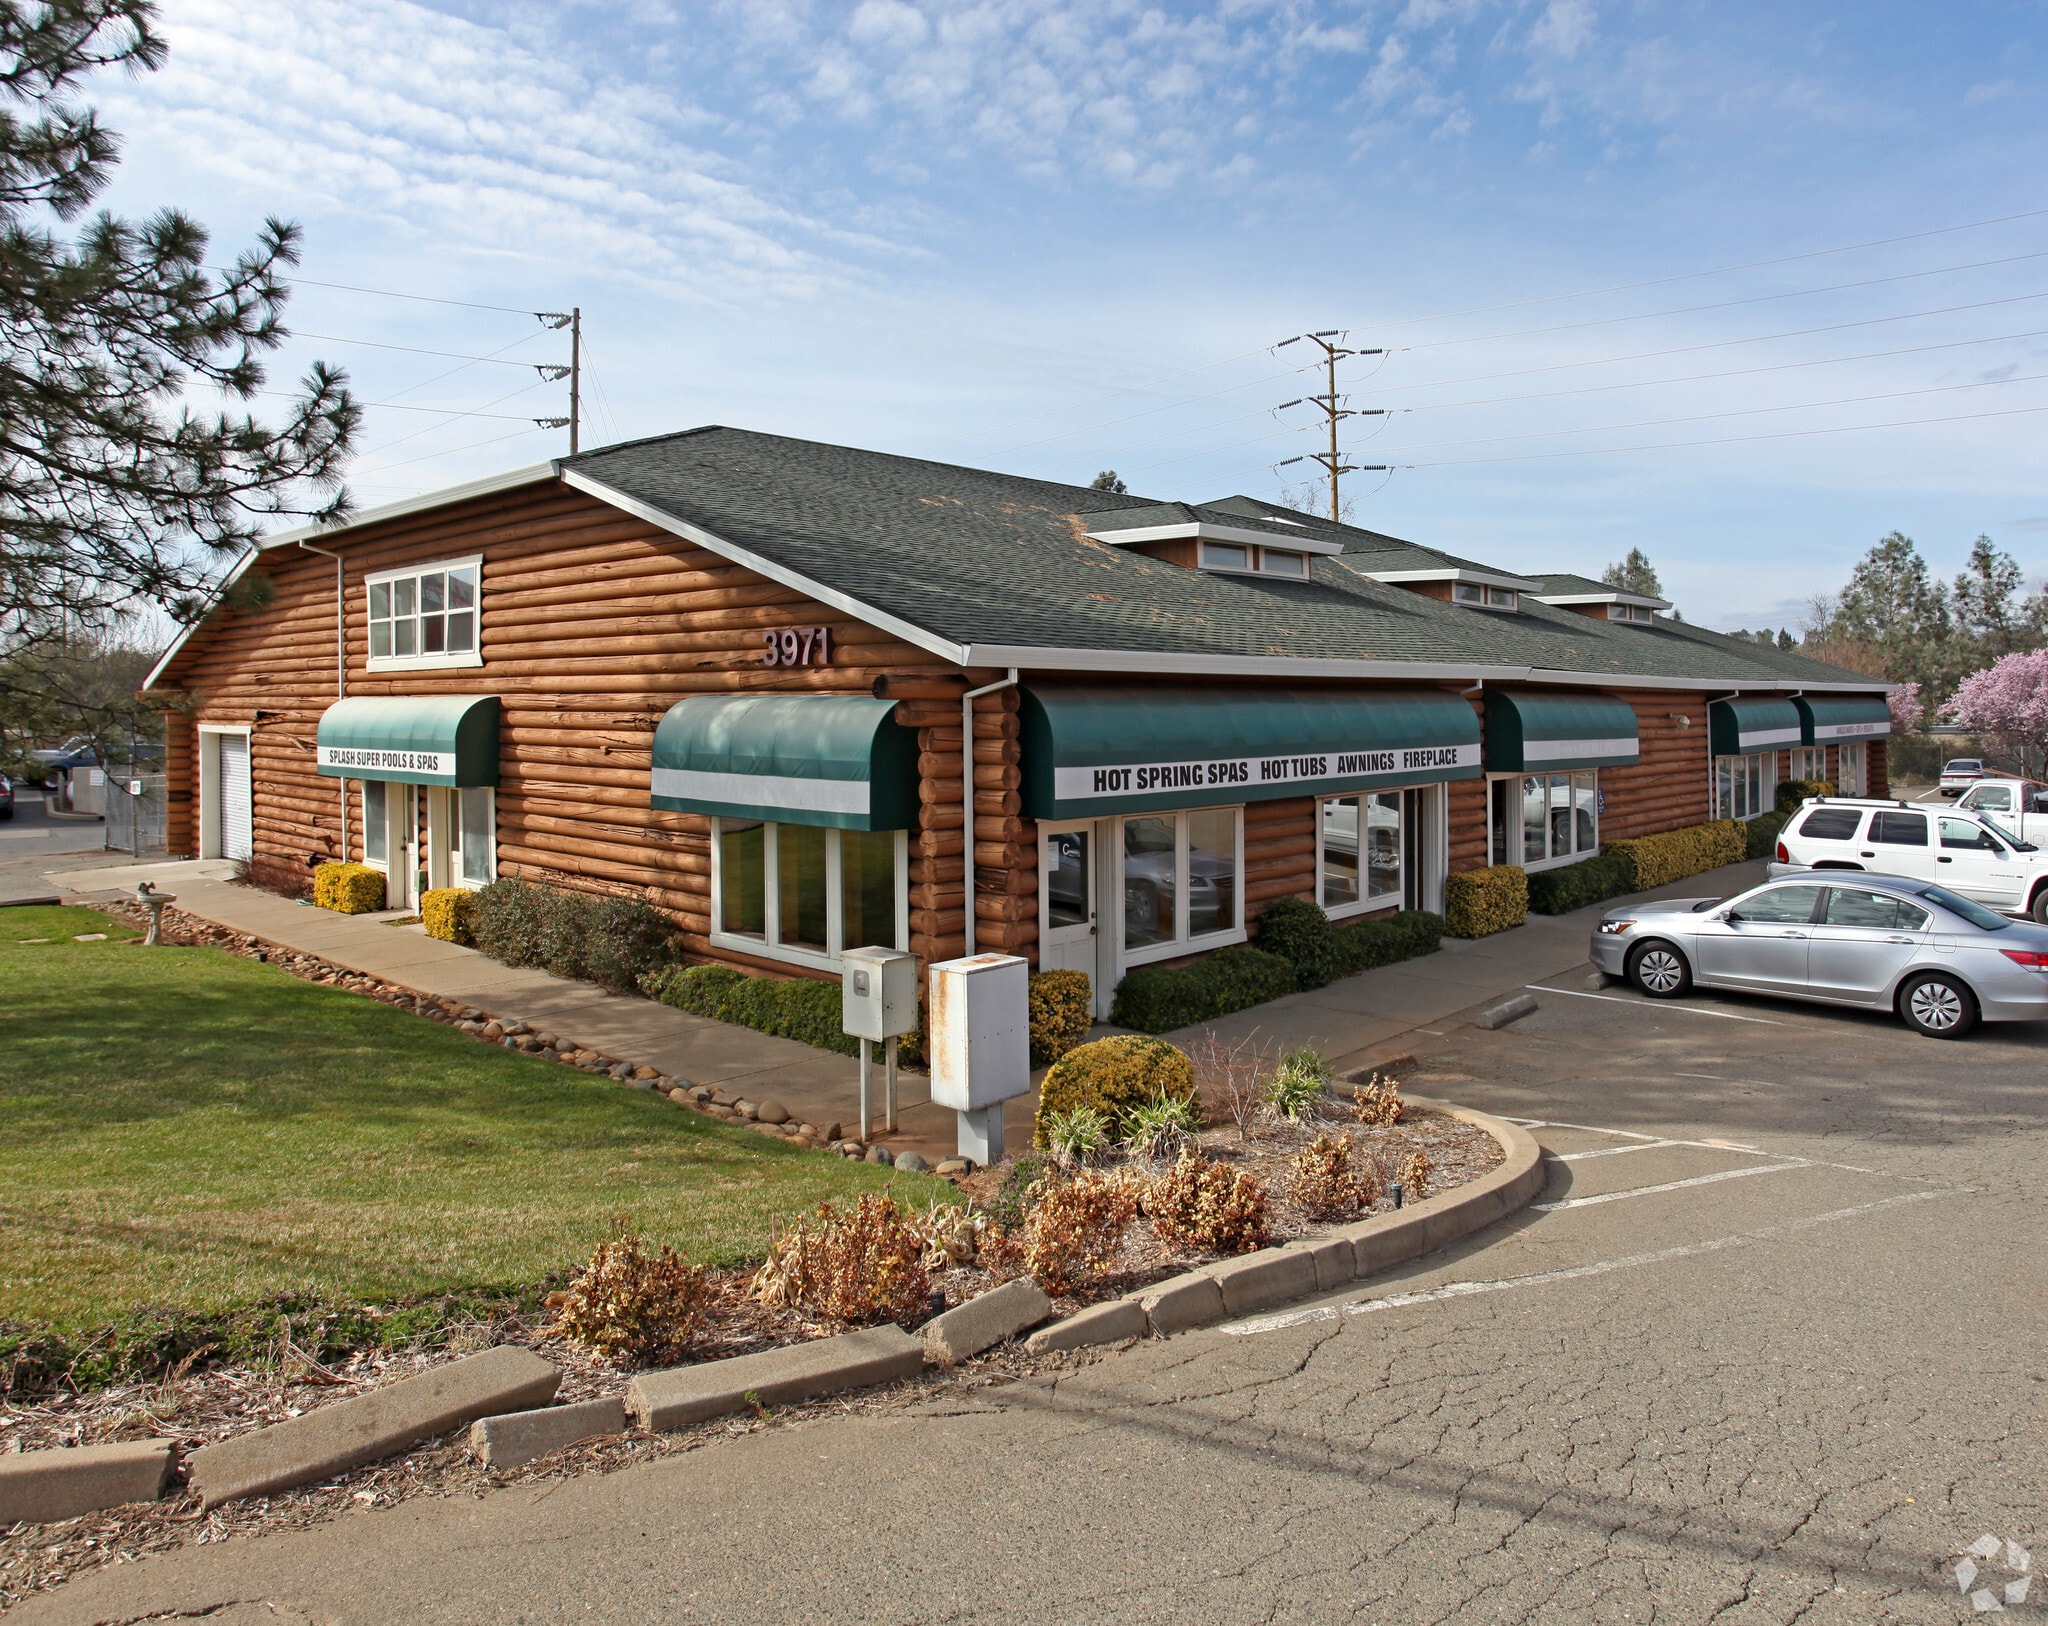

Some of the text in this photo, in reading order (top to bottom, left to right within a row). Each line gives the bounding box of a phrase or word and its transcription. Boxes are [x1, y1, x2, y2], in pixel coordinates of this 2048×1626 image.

[763, 627, 828, 667] 3971
[329, 750, 439, 771] SPLASH SUPER POOLS & SPAS
[1094, 748, 1457, 792] HOT SPRING SPAS HOT TUBS AWNINGS FIREPLACE
